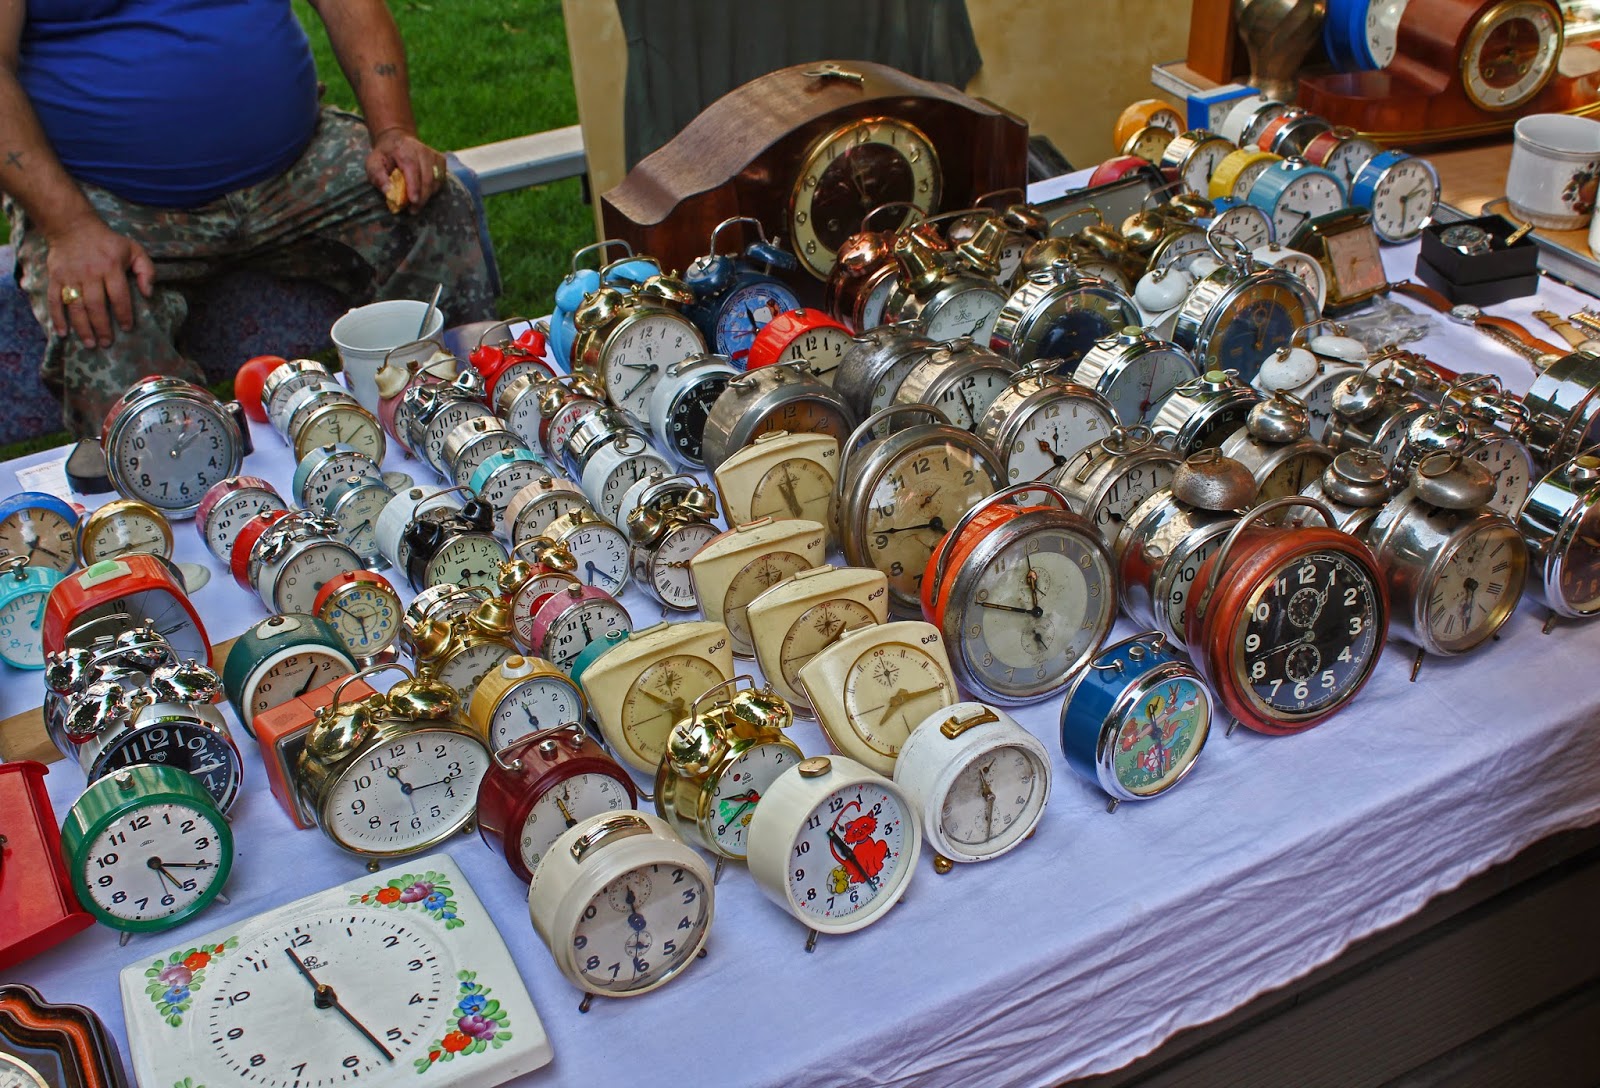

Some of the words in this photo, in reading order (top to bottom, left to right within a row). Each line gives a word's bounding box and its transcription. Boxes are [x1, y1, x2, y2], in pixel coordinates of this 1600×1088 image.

[919, 179, 928, 193] 3
[641, 326, 652, 339] 12
[623, 337, 633, 349] 11
[806, 336, 817, 351] 12
[835, 344, 841, 357] 2
[702, 381, 714, 390] 12
[962, 377, 975, 390] 12
[1045, 405, 1059, 419] 12
[198, 420, 208, 432] 2
[1026, 420, 1035, 432] 11
[1087, 419, 1097, 431] 2
[132, 437, 145, 451] 10
[210, 436, 219, 449] 3
[680, 438, 688, 446] 8
[1477, 451, 1488, 460] 12
[130, 458, 139, 470] 9
[208, 457, 216, 468] 4
[912, 458, 930, 475] 12
[198, 472, 206, 485] 5
[963, 471, 974, 486] 2
[1009, 468, 1019, 478] 9
[141, 474, 151, 487] 8
[1126, 470, 1142, 490] 12
[1507, 476, 1513, 487] 3
[160, 483, 168, 496] 7
[180, 482, 189, 495] 6
[1109, 484, 1118, 504] 11
[236, 501, 247, 509] 12
[218, 520, 230, 529] 10
[579, 534, 591, 545] 12
[876, 535, 888, 549] 9
[1025, 538, 1039, 554] 12
[454, 543, 465, 555] 12
[304, 555, 315, 565] 12
[442, 552, 451, 564] 11
[612, 553, 620, 561] 3
[1081, 554, 1091, 568] 2
[1196, 550, 1206, 562] 11
[334, 558, 341, 568] 2
[488, 558, 495, 568] 3
[890, 562, 903, 576] 8
[435, 565, 445, 577] 10
[1179, 568, 1195, 582] 10
[1298, 565, 1316, 584] 12
[285, 577, 296, 588] 10
[1274, 578, 1286, 596] 11
[1090, 584, 1100, 597] 3
[1344, 588, 1357, 606] 2
[21, 594, 35, 604] 12
[1173, 592, 1183, 604] 9
[579, 613, 591, 622] 12
[1252, 602, 1269, 622] 10
[1, 615, 14, 625] 10
[1083, 618, 1093, 629] 4
[1349, 617, 1361, 635] 3
[970, 625, 981, 639] 9
[11, 639, 20, 649] 8
[560, 635, 572, 646] 10
[1246, 634, 1260, 652] 9
[559, 650, 567, 658] 9
[983, 652, 993, 667] 8
[1065, 647, 1075, 661] 5
[1338, 646, 1352, 662] 4
[284, 658, 298, 668] 12
[322, 662, 331, 671] 2
[1005, 668, 1015, 682] 7
[1037, 664, 1046, 679] 6
[1252, 661, 1266, 679] 8
[1322, 670, 1334, 688] 5
[258, 684, 271, 694] 10
[522, 688, 532, 697] 12
[1270, 679, 1282, 697] 7
[1294, 682, 1308, 699] 6
[501, 712, 511, 720] 10
[142, 728, 169, 752] 12
[174, 729, 185, 747] 1
[122, 742, 141, 764] 11
[187, 737, 207, 757] 2
[390, 745, 405, 759] 12
[416, 742, 422, 753] 1
[435, 745, 447, 758] 2
[370, 758, 384, 771] 11
[448, 762, 461, 777] 3
[203, 774, 218, 791] 4
[352, 776, 371, 792] 10
[445, 787, 455, 798] 4
[351, 800, 365, 815] 9
[609, 799, 617, 809] 3
[828, 798, 844, 813] 12
[874, 803, 882, 815] 2
[431, 806, 441, 817] 5
[129, 816, 151, 831] 12
[163, 814, 171, 824] 1
[369, 816, 381, 829] 8
[411, 817, 421, 829] 6
[527, 814, 537, 825] 10
[807, 815, 821, 830] 11
[181, 820, 195, 834] 2
[390, 821, 399, 833] 7
[884, 823, 893, 835] 3
[109, 832, 126, 846] 11
[195, 838, 209, 850] 3
[795, 842, 810, 857] 10
[96, 853, 118, 868] 10
[98, 876, 113, 887] 9
[672, 869, 684, 884] 2
[795, 869, 804, 881] 9
[183, 879, 197, 892] 5
[112, 891, 127, 903] 8
[161, 894, 175, 906] 6
[682, 888, 696, 904] 3
[807, 888, 816, 900] 8
[850, 891, 859, 902] 6
[135, 898, 149, 910] 7
[827, 897, 834, 910] 7
[678, 916, 691, 930] 4
[292, 934, 312, 949] 12
[383, 936, 399, 949] 2
[574, 935, 587, 949] 9
[663, 939, 676, 955] 5
[253, 961, 268, 972] 11
[408, 959, 423, 971] 3
[587, 956, 600, 970] 8
[635, 958, 649, 972] 6
[608, 962, 620, 978] 7
[229, 991, 250, 1005] 10
[410, 994, 423, 1005] 4
[228, 1028, 243, 1040] 9
[387, 1028, 402, 1041] 5
[250, 1054, 265, 1066] 8
[343, 1056, 359, 1068] 6
[291, 1063, 306, 1076] 7
